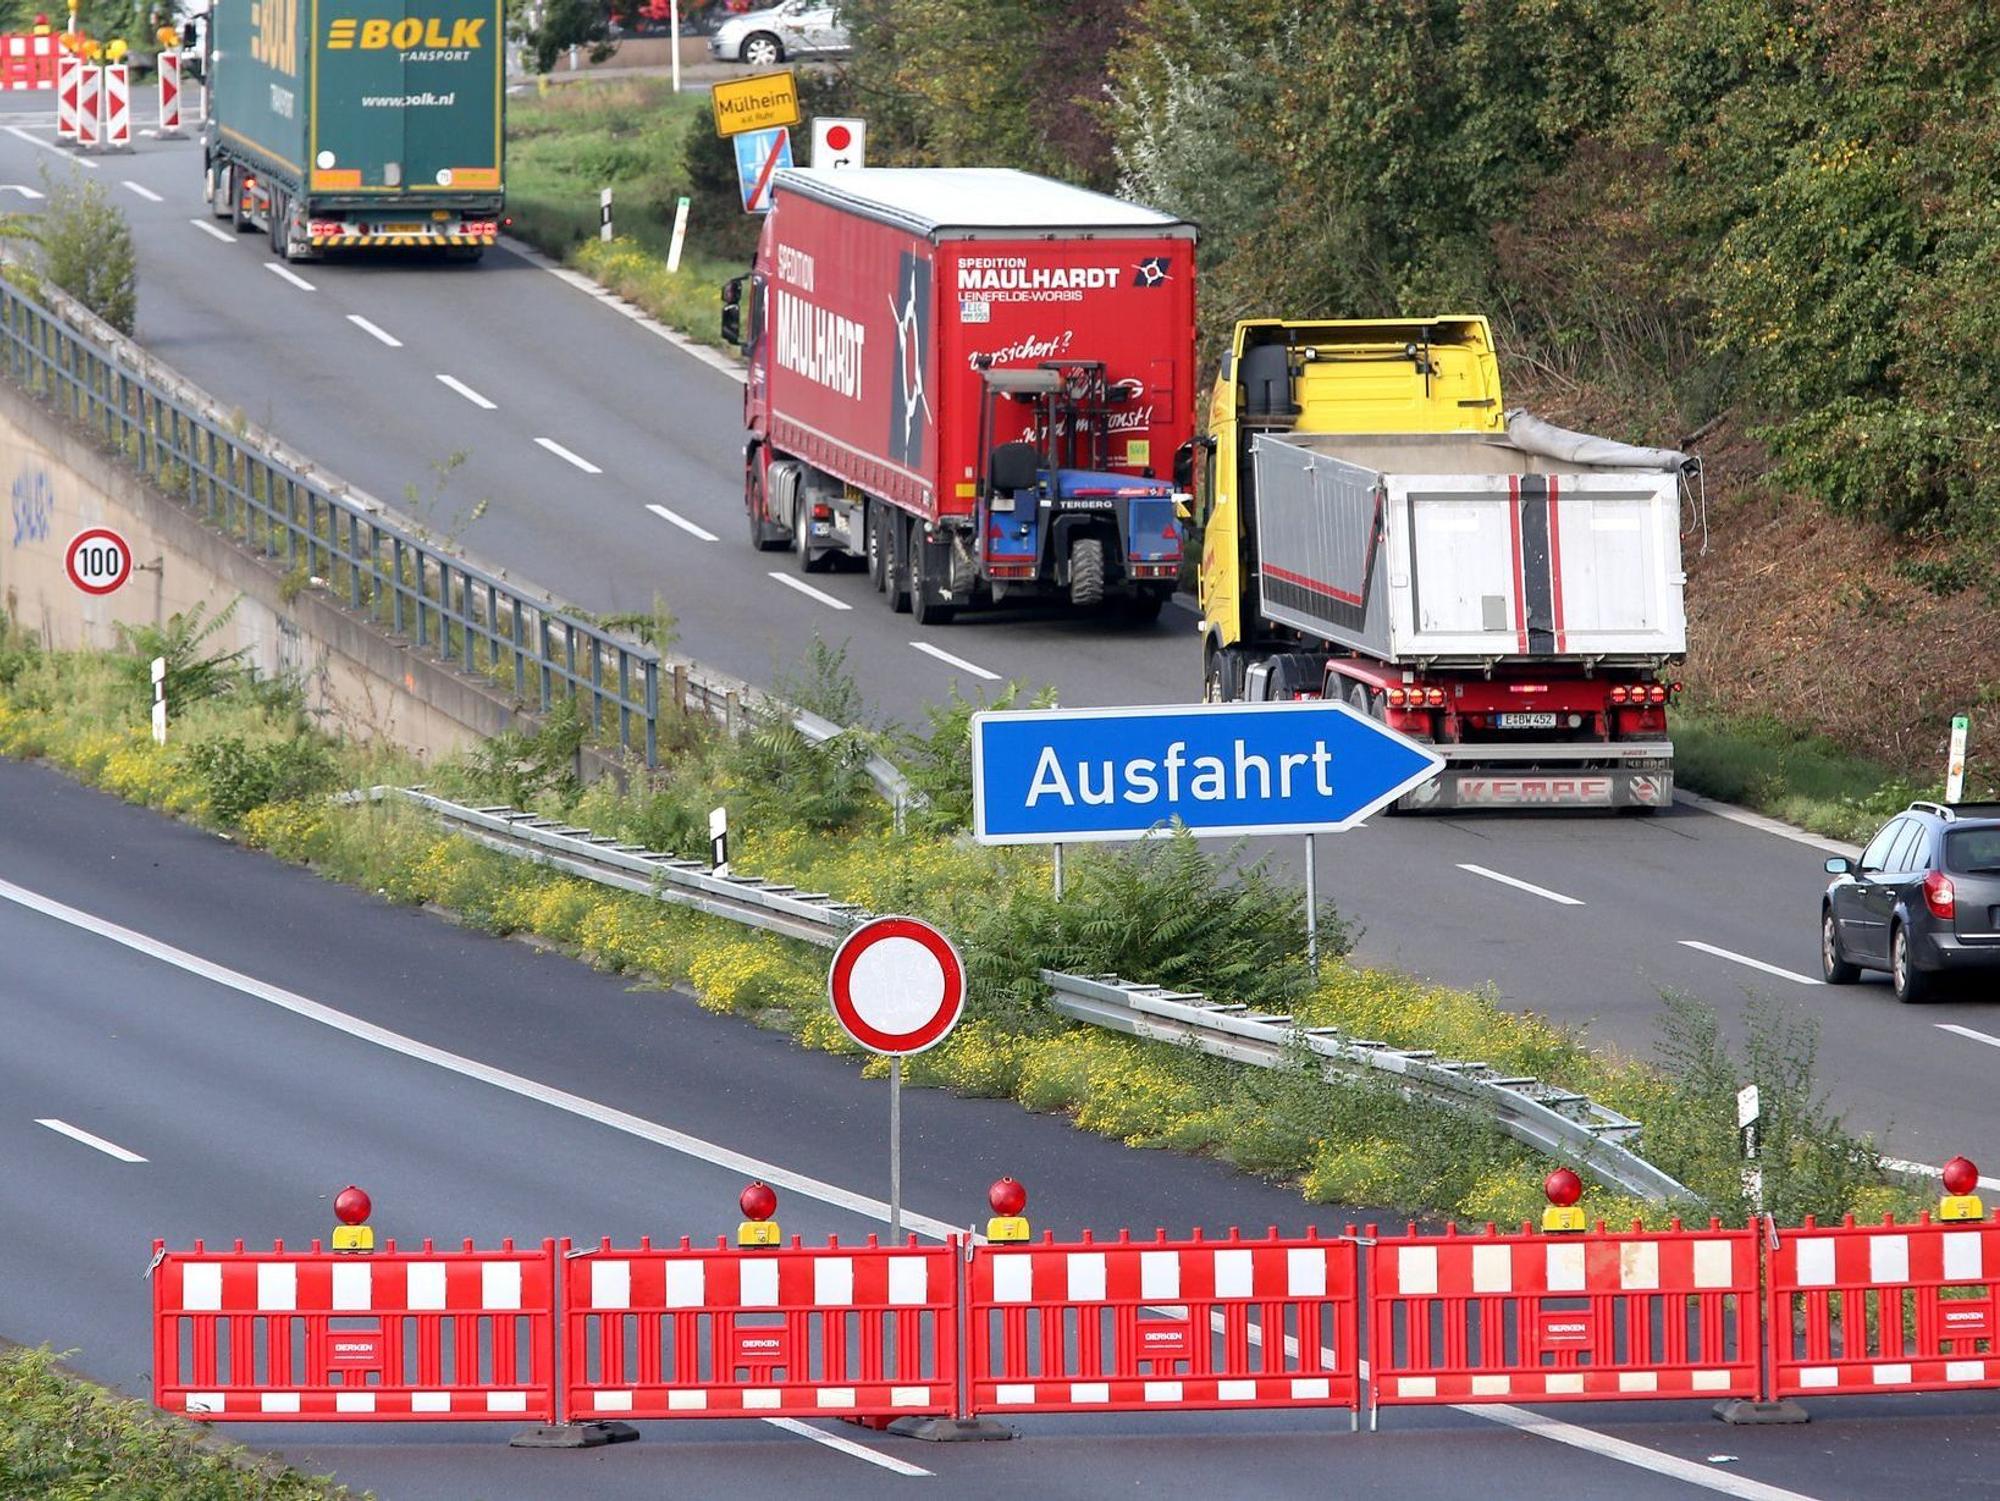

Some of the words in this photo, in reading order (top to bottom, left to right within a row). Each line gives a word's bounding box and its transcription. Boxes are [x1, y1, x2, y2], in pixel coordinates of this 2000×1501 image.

[360, 18, 487, 49] BOLK
[778, 243, 815, 293] SPEDITION
[958, 258, 1027, 268] SPEDITION
[958, 268, 1120, 289] MAULHARDT
[958, 290, 1083, 302] LEINEFELDE-WORBIS
[777, 289, 864, 401] MAULHARDT
[1060, 501, 1113, 509] TERBERG
[79, 547, 119, 577] 100
[1025, 739, 1333, 808] Ausfahrt
